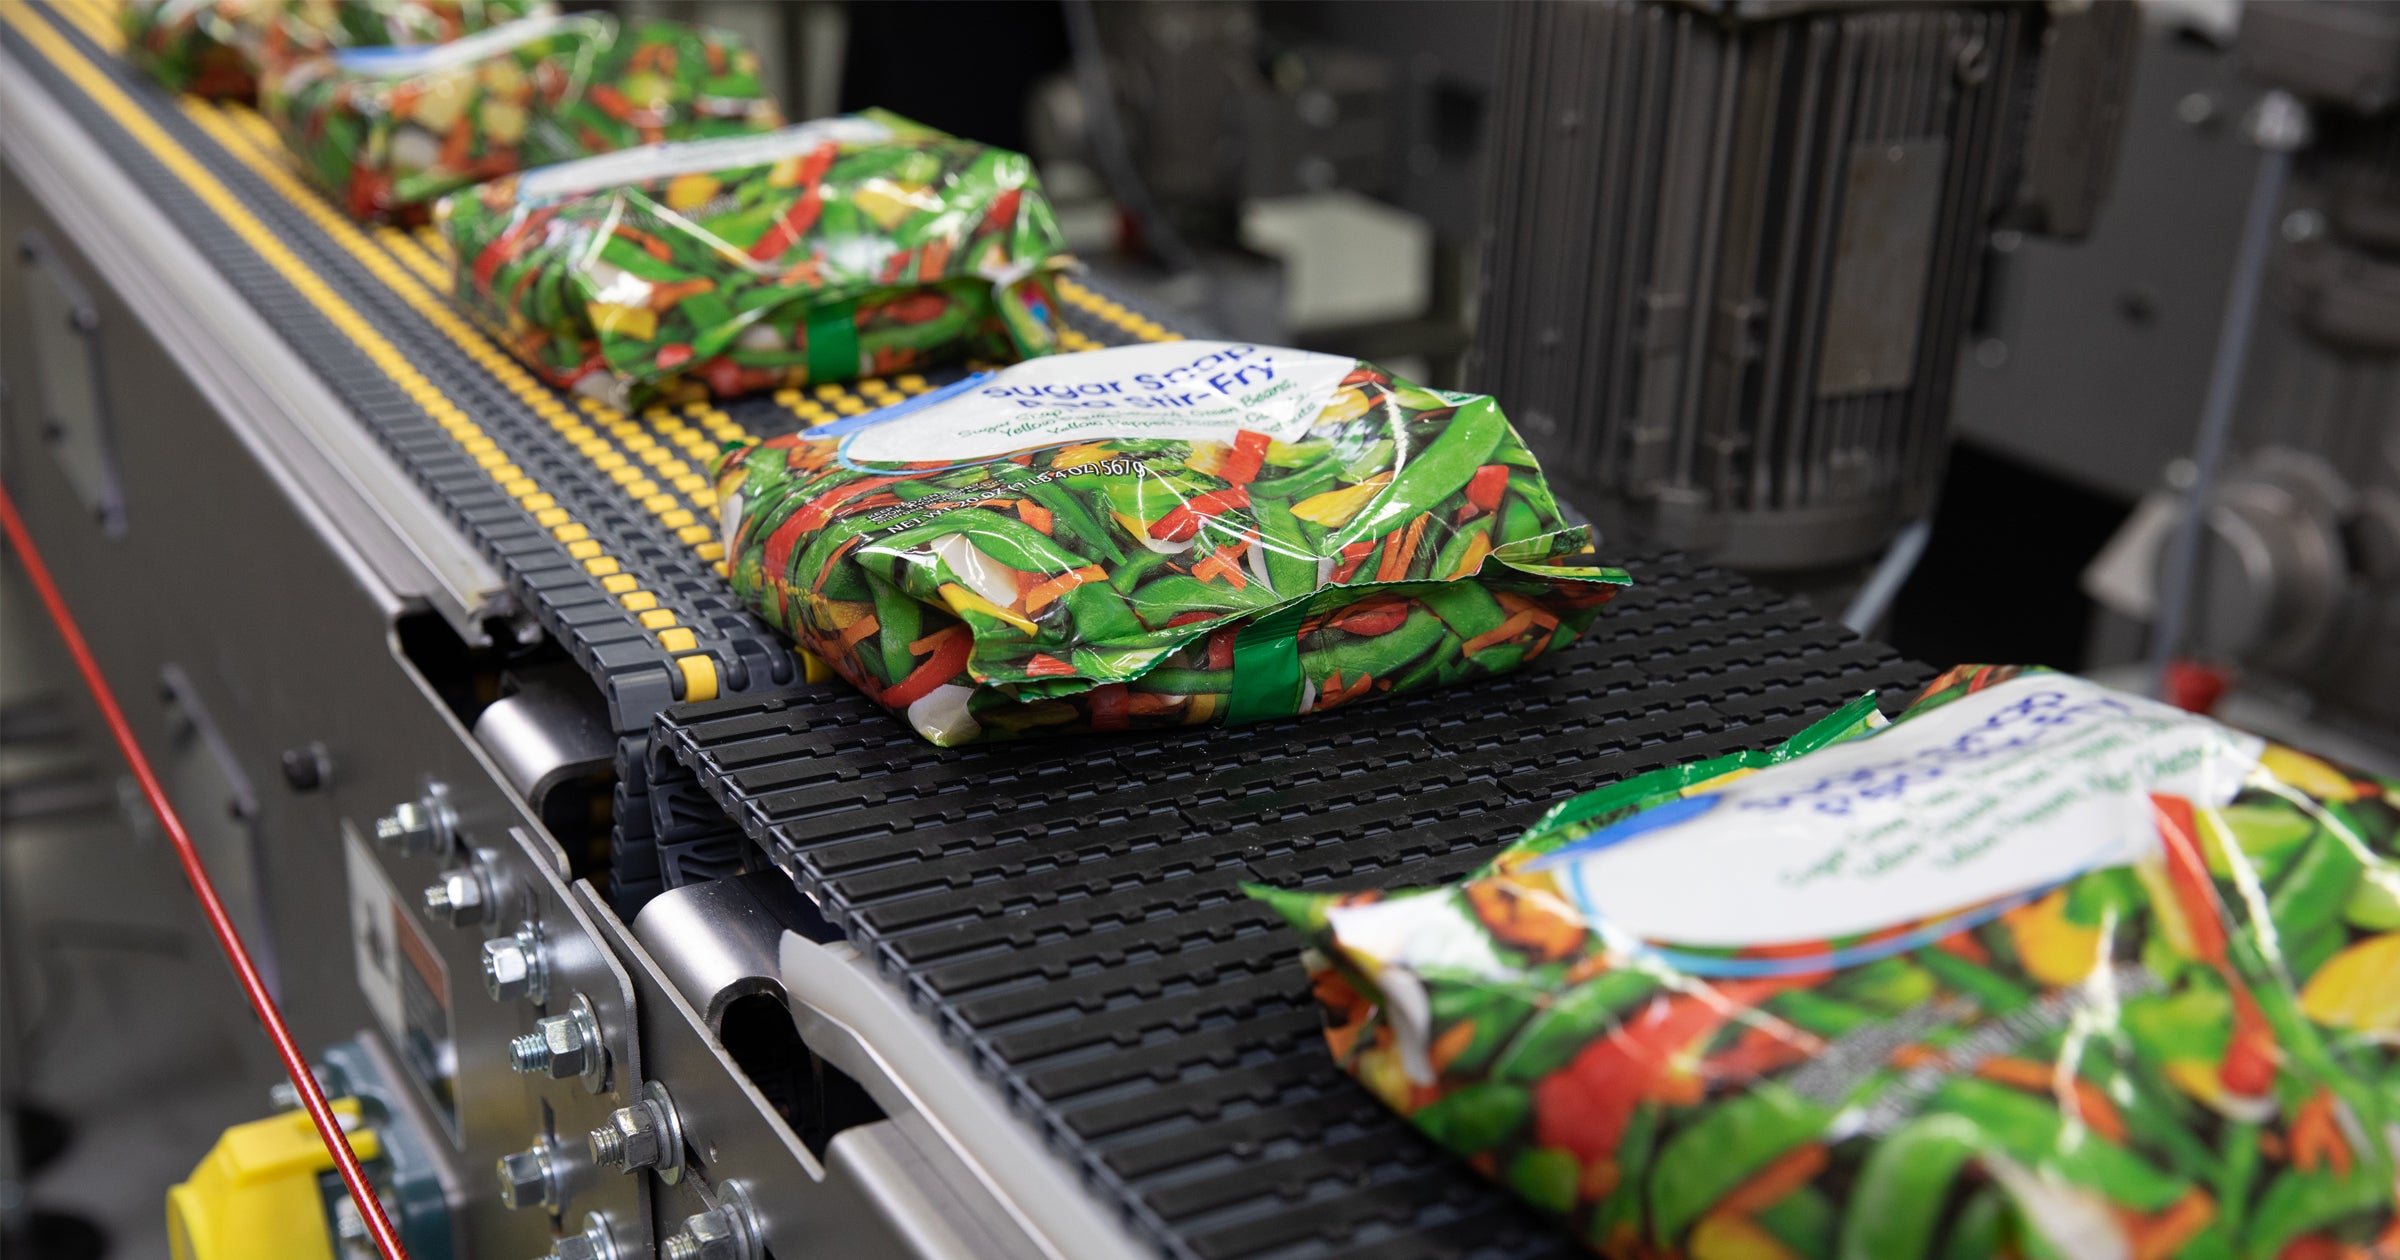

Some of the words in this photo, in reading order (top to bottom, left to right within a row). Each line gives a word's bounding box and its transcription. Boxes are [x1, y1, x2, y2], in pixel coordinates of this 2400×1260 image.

[982, 381, 1123, 399] Sugar
[1124, 356, 1275, 409] Stir-Fry
[1000, 417, 1056, 437] Yellow
[887, 517, 922, 534] NET
[922, 506, 952, 520] WT
[959, 497, 979, 508] 20
[980, 487, 1002, 500] OZ
[1007, 481, 1027, 492] (1
[1027, 470, 1053, 486] LB
[1055, 470, 1068, 480] 4
[1067, 463, 1100, 476] OZ)
[1100, 458, 1147, 478] 567g
